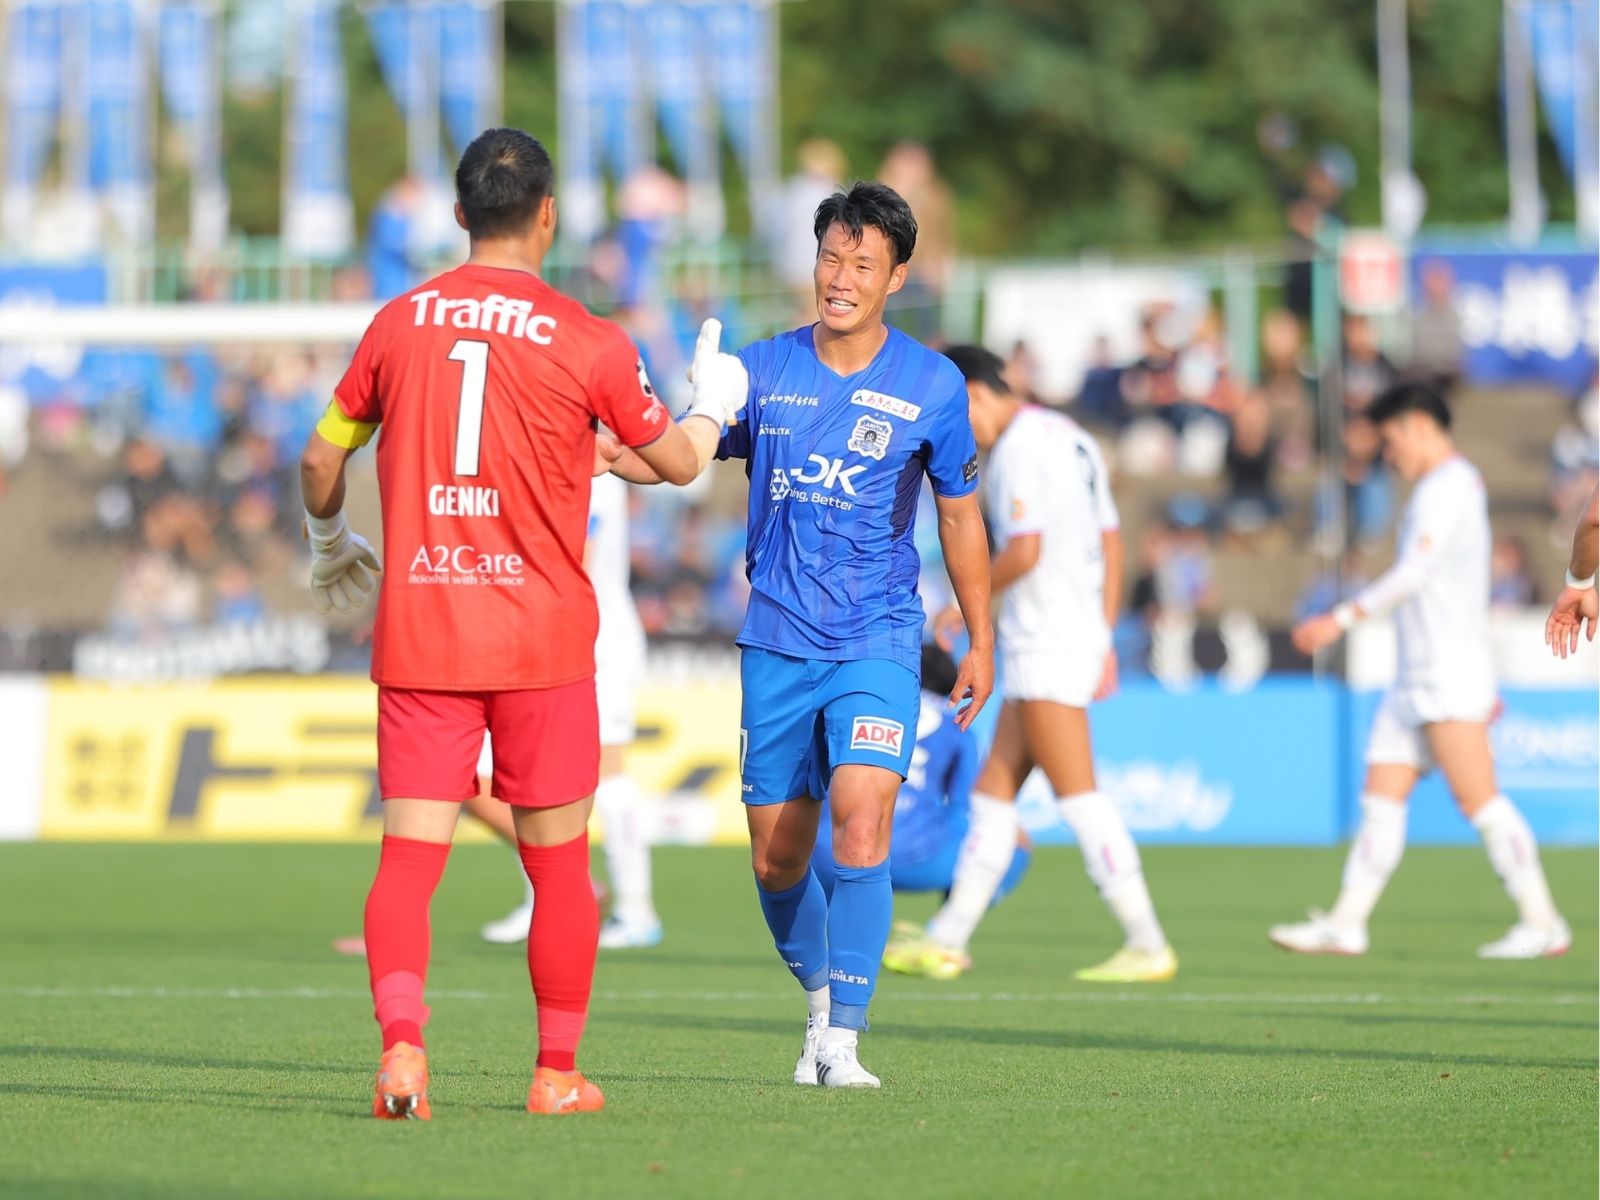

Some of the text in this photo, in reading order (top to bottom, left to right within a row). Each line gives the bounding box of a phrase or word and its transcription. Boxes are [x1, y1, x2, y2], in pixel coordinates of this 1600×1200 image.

[411, 289, 556, 344] Traffic
[447, 338, 491, 477] 1
[790, 453, 869, 497] DK
[429, 484, 500, 518] GENKI
[811, 492, 853, 510] Better
[409, 544, 525, 575] A2Care
[452, 574, 477, 585] with
[480, 575, 525, 586] Science
[854, 724, 902, 748] ADK
[829, 972, 868, 985] ATHLETA
